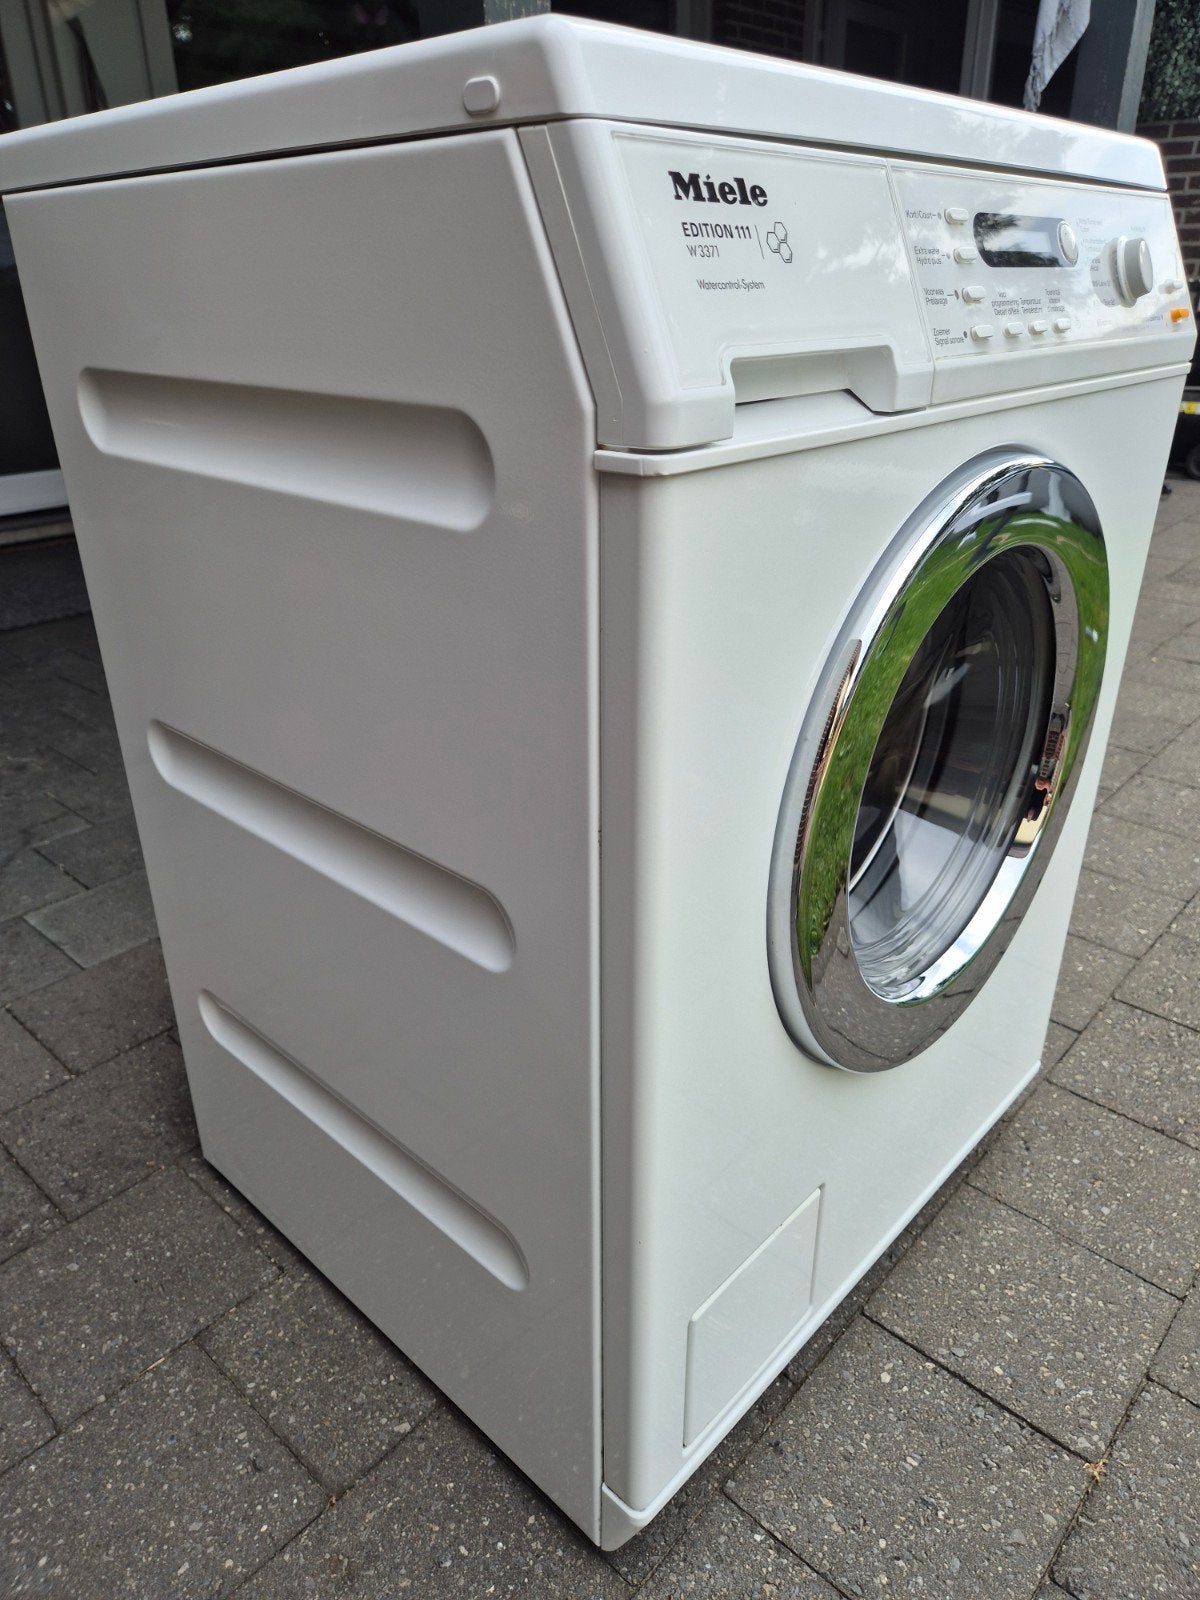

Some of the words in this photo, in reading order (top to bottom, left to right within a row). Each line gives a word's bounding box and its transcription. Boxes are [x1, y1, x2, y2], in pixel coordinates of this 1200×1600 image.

[668, 171, 768, 207] Miele
[681, 222, 734, 239] EDITION
[734, 225, 752, 240] 111
[686, 245, 698, 257] W
[699, 245, 720, 258] 3371
[697, 279, 765, 292] Watercontrol-System
